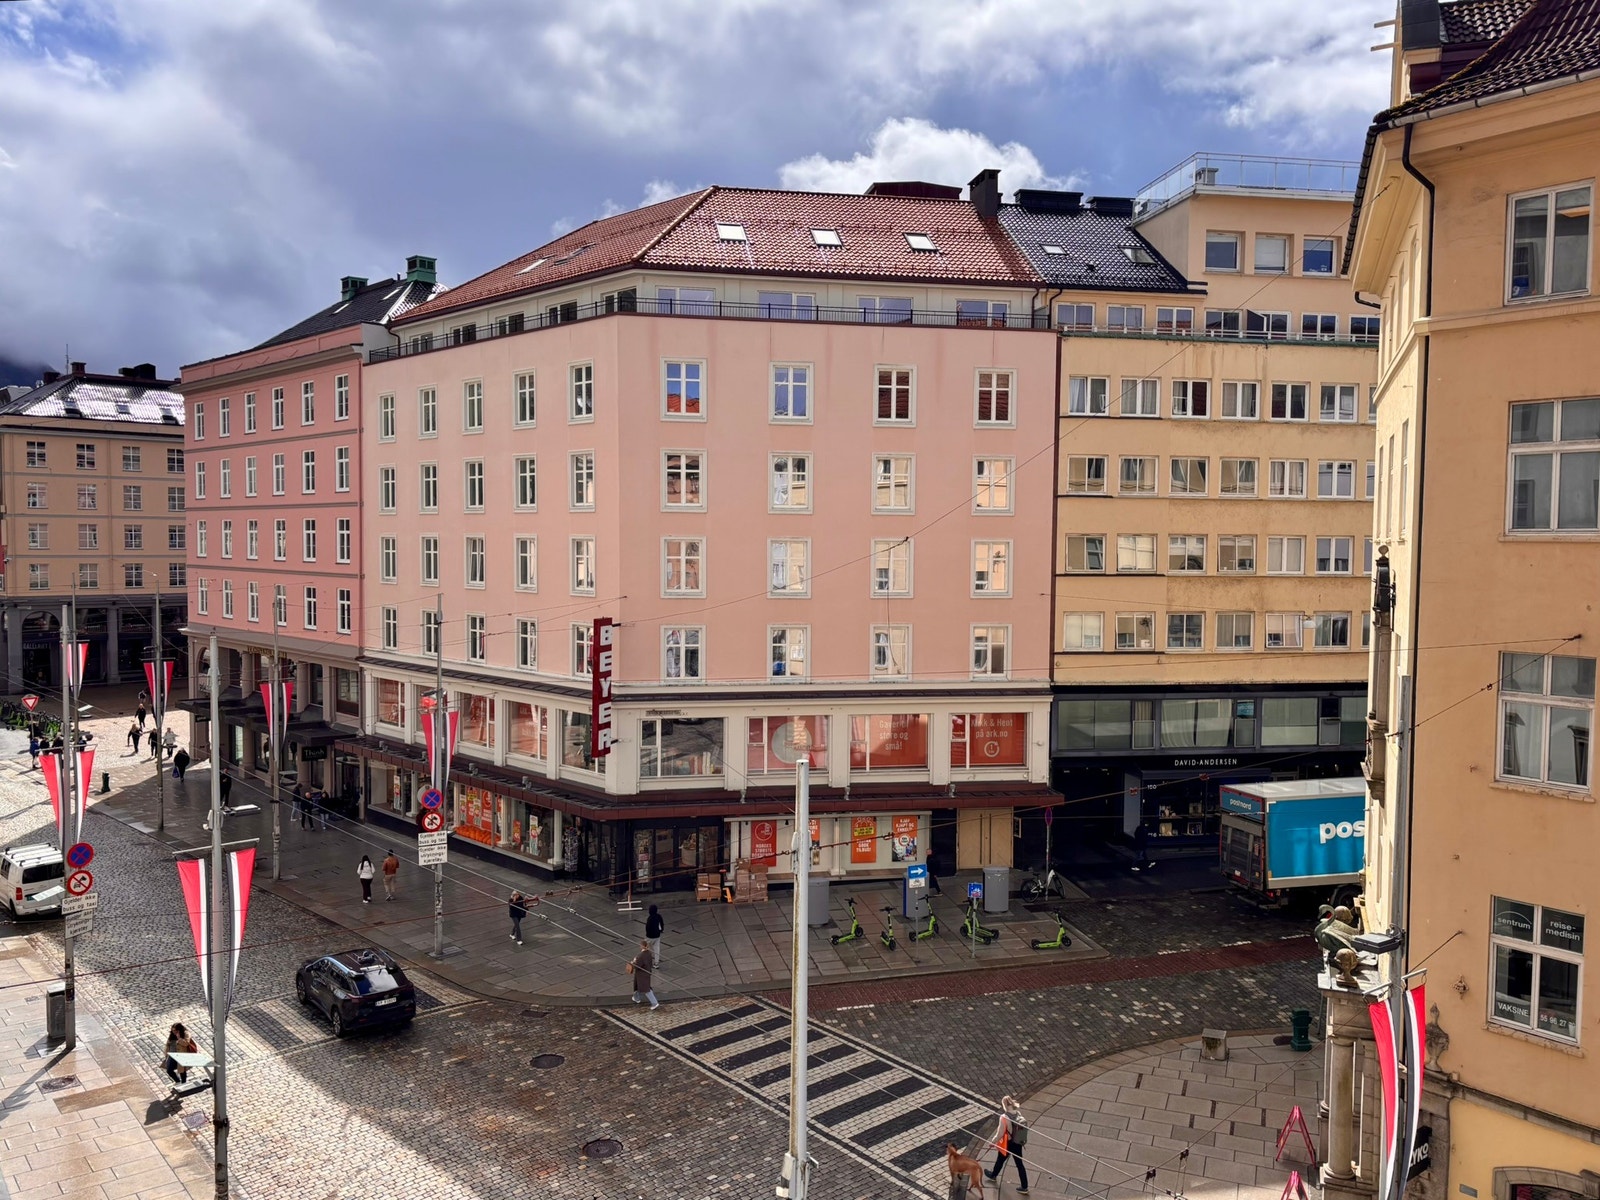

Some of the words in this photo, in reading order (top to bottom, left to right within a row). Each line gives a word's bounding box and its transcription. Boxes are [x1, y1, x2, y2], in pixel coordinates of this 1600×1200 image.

[598, 625, 612, 751] BEYER
[997, 719, 1013, 727] Hent
[879, 732, 898, 740] store
[899, 732, 909, 741] og
[975, 729, 984, 739] på
[986, 729, 1008, 738] ark.no
[1229, 798, 1252, 810] postnord
[1497, 917, 1531, 930] sentrum
[1550, 920, 1577, 931] reise-
[1545, 927, 1581, 941] medisin
[1497, 1001, 1529, 1017] VAKSINE
[1559, 1019, 1567, 1027] 27
